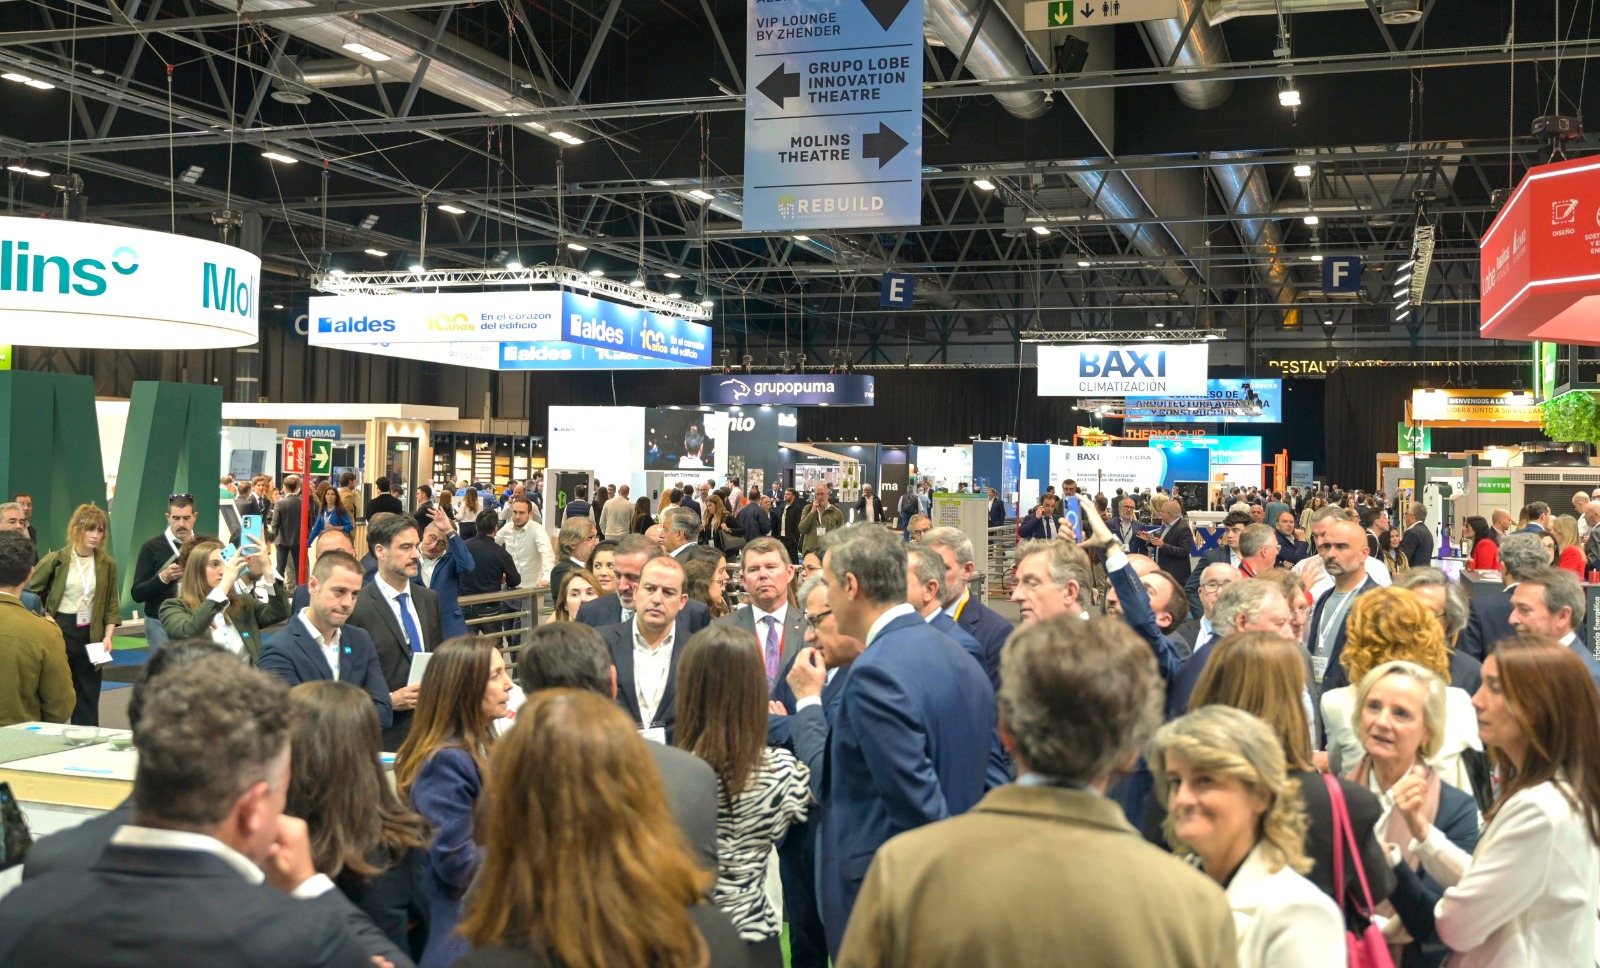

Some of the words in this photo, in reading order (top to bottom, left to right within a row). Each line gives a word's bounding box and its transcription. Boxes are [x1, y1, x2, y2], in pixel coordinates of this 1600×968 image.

[757, 17, 778, 28] VIP
[782, 13, 837, 27] LOUNGE
[756, 30, 773, 41] BY
[777, 25, 841, 40] ZHENDER
[808, 60, 863, 75] GRUPO
[868, 57, 910, 71] LOBE
[808, 72, 906, 89] INNOVATION
[808, 88, 881, 104] THEATRE
[790, 134, 851, 149] MOLINS
[778, 149, 850, 163] THEATRE
[798, 196, 884, 213] REBUILD
[1552, 228, 1575, 237] DISEÑO
[1332, 261, 1350, 287] F
[889, 278, 905, 302] E
[481, 313, 494, 321] En
[497, 313, 506, 321] el
[508, 311, 552, 320] corazón
[334, 315, 396, 333] aldes
[480, 322, 496, 330] del
[499, 321, 537, 330] edificio
[581, 317, 624, 345] aldes
[517, 345, 572, 361] aldes
[651, 342, 668, 354] años
[1079, 350, 1166, 377] BAXI
[754, 382, 835, 397] grupopuma
[1078, 379, 1166, 392] CLIMATIZACIÓN
[1225, 390, 1239, 398] DE
[305, 429, 336, 438] HOMAG
[1126, 429, 1206, 440] THERMOCHIP
[1076, 452, 1100, 461] BAXI
[881, 482, 898, 491] ma
